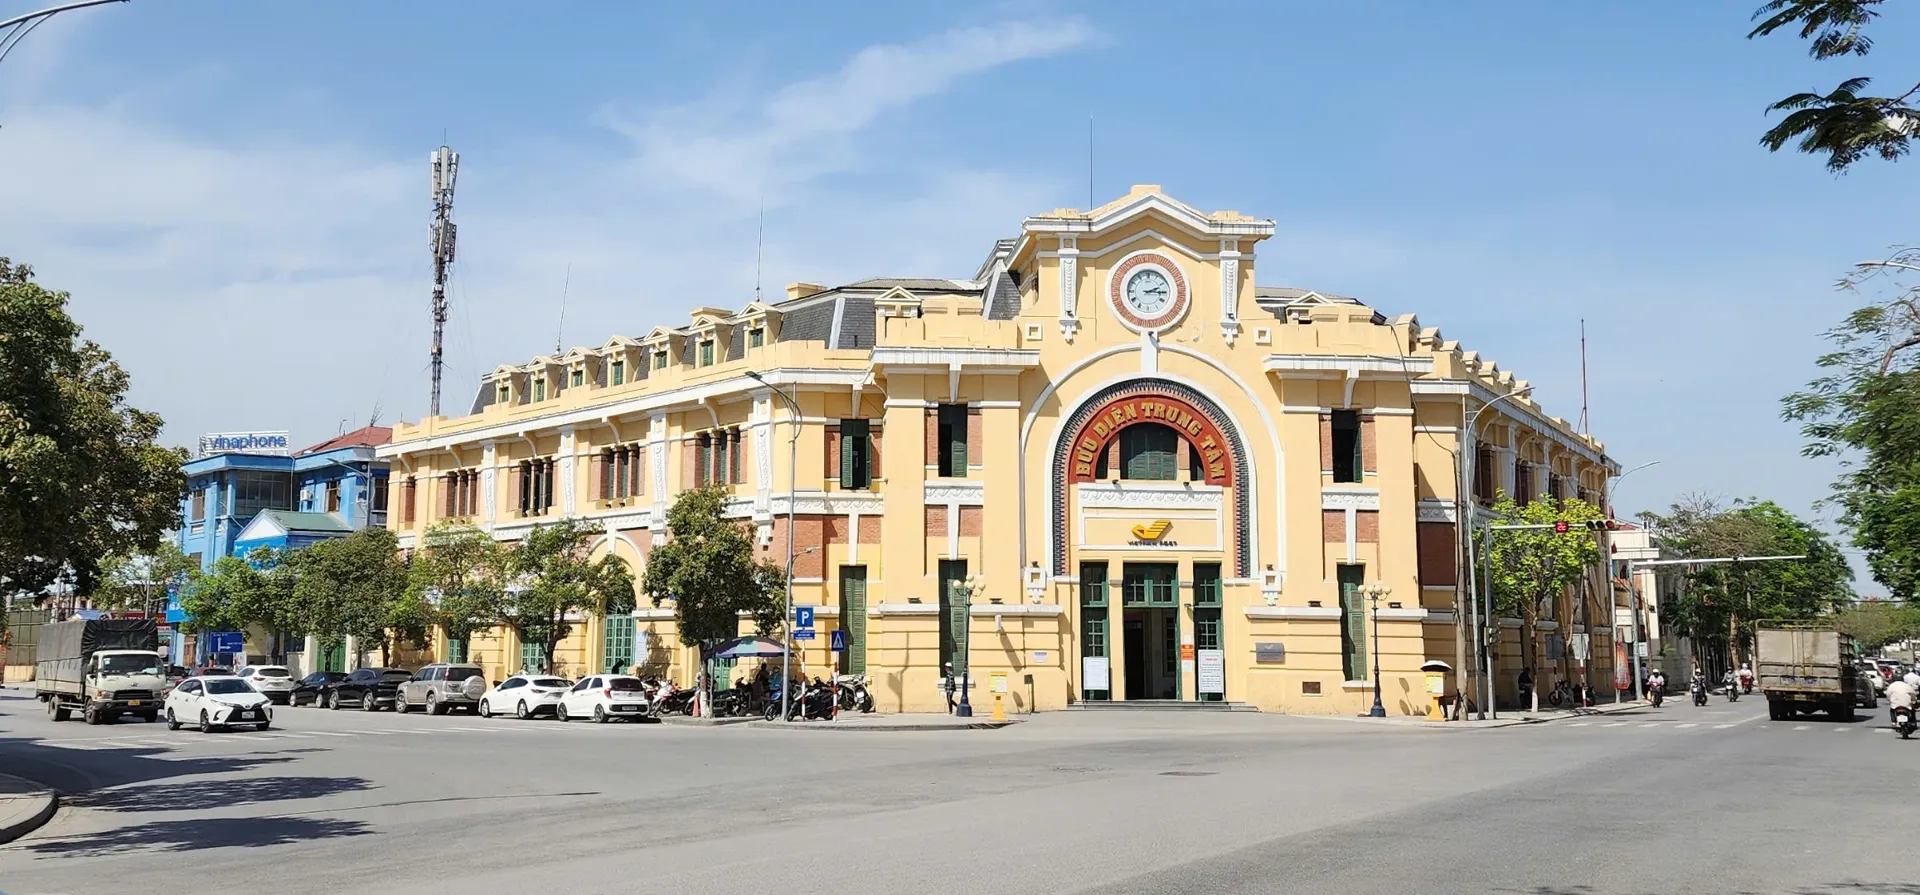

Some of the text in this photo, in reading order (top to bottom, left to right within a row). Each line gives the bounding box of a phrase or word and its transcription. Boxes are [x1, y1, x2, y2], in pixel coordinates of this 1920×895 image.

[209, 434, 287, 451] vinaphone
[1141, 402, 1202, 436] TRUNG
[1200, 434, 1226, 479] TÂM
[802, 611, 810, 625] P
